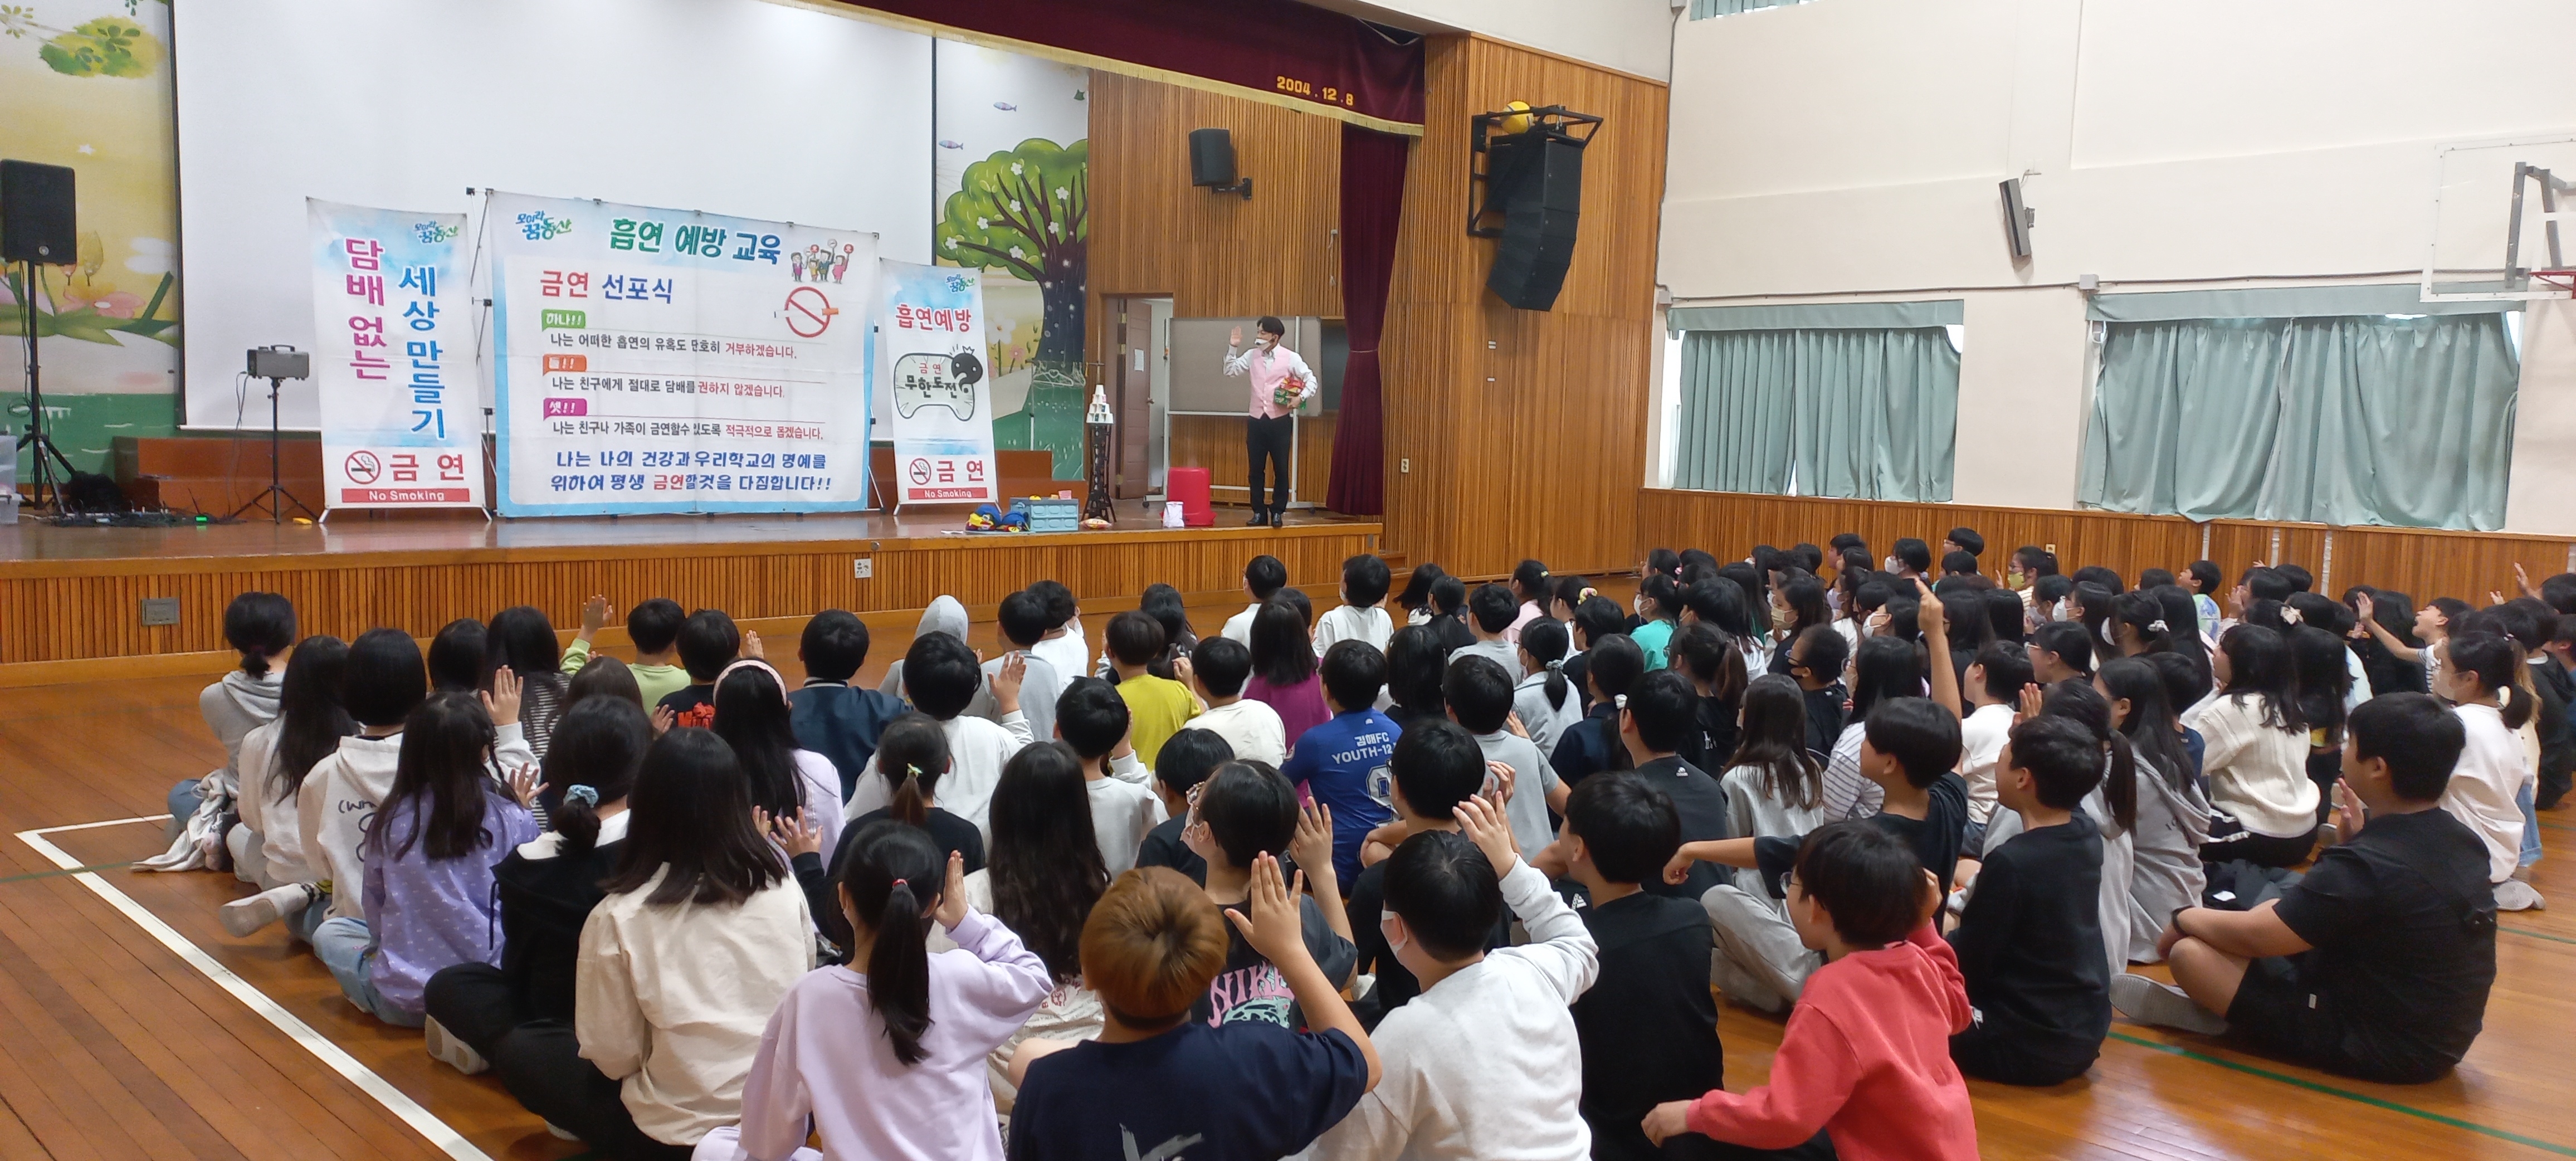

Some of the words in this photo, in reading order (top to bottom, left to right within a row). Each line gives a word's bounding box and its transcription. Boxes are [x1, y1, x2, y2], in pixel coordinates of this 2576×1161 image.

[522, 217, 572, 240] 꿈동산
[610, 218, 663, 252] 흡연
[675, 225, 726, 257] 예방
[733, 233, 780, 265] 교육
[345, 237, 385, 306] 담배
[398, 266, 440, 331] 세상
[540, 270, 588, 298] 금연
[602, 274, 672, 304] 선포식
[547, 313, 582, 326] 하나!!
[349, 316, 390, 380] 없는
[551, 333, 573, 347] 나는
[578, 334, 612, 348] 어떠한
[617, 335, 650, 350] 흡연의
[655, 337, 686, 352] 유혹도
[725, 342, 797, 359] 거부하겠습니다.
[407, 340, 445, 439] 만들기
[552, 377, 574, 391] 나는
[579, 377, 623, 391] 친구에게
[628, 378, 661, 392] 절대로
[665, 380, 695, 394] 담배를
[697, 381, 729, 395] 권하지
[734, 383, 785, 398] 않겠습니다.
[905, 374, 958, 399] 무한도전
[553, 421, 574, 435] 나는
[579, 421, 609, 435] 친구나
[614, 421, 646, 435] 가족이
[650, 422, 690, 436] 금연할수
[725, 424, 773, 438] 적극적으로
[557, 451, 591, 467] 나는
[601, 451, 633, 467] 나의
[642, 451, 690, 467] 건강과
[695, 451, 775, 469] 우리학교의
[782, 453, 826, 469] 명예를
[551, 474, 604, 491] 위하여
[611, 474, 645, 490] 평생
[739, 475, 831, 491] 다짐합니다!!
[924, 489, 936, 498] No
[938, 489, 973, 499] Smoking
[369, 490, 387, 501] No
[390, 490, 445, 501] Smoking
